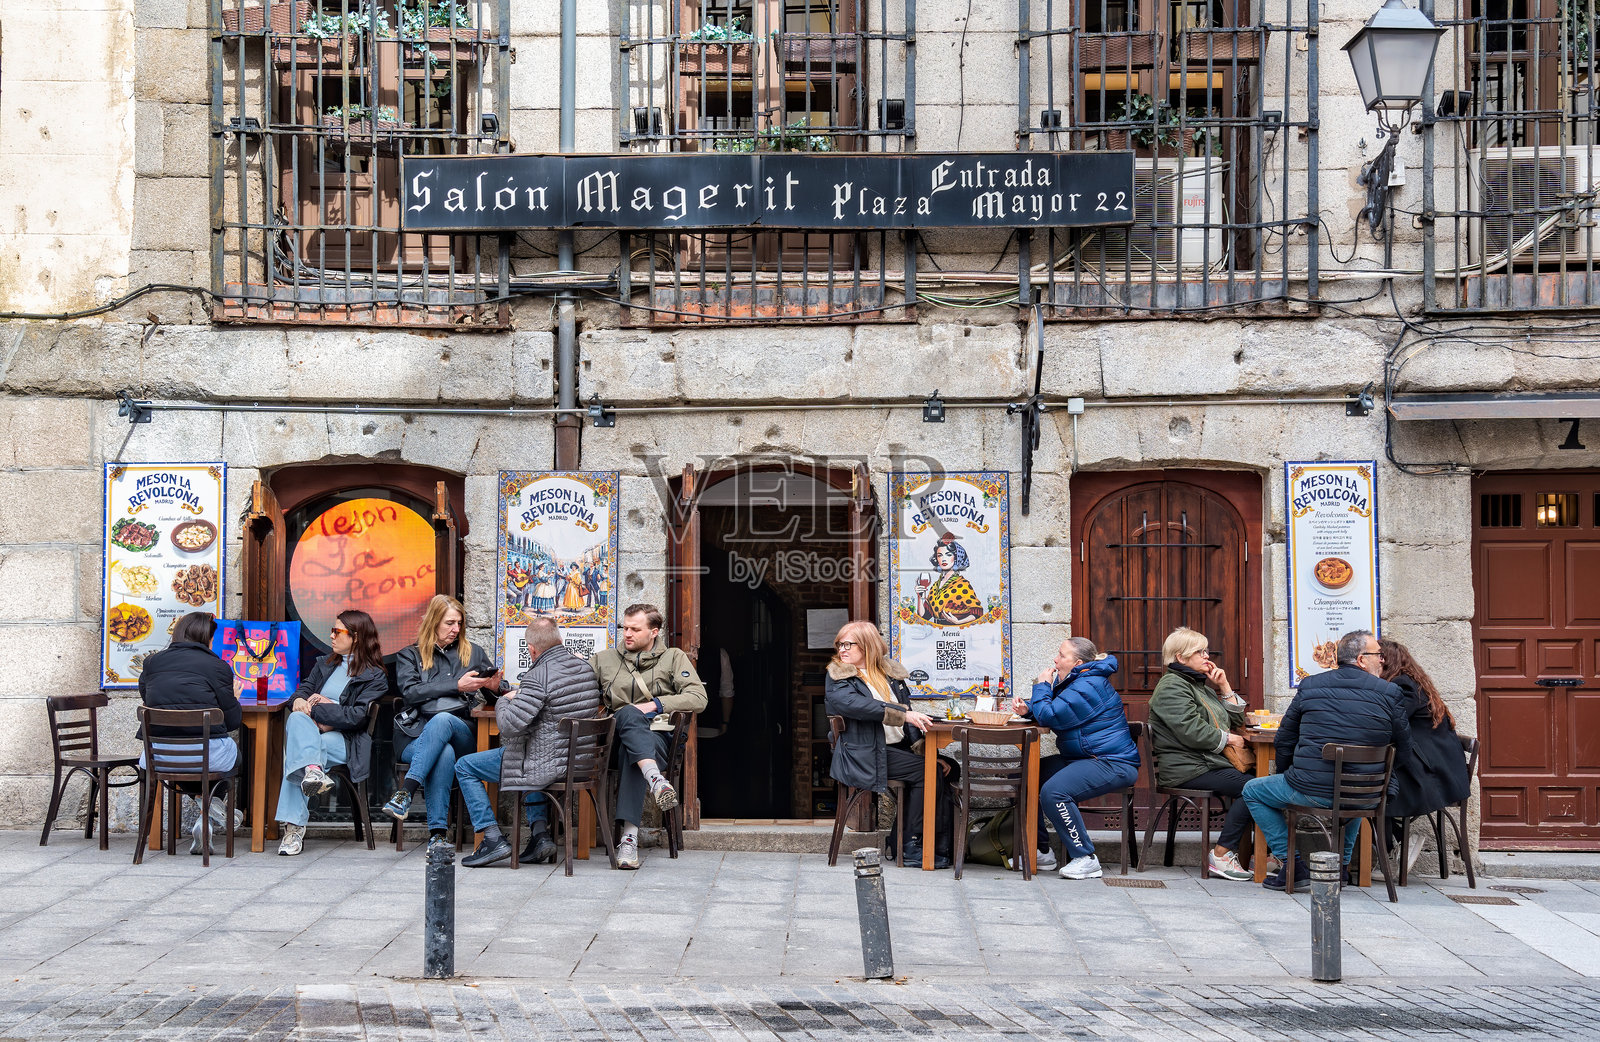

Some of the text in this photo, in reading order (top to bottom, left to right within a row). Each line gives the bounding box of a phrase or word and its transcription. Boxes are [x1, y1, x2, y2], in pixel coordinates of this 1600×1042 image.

[931, 158, 1052, 195] Entrada
[408, 169, 799, 222] Salón Magerit
[831, 181, 1130, 222] Plaza Mayor 22
[1183, 194, 1206, 208] FUJITS
[136, 473, 191, 490] MESON LA
[1300, 474, 1358, 492] MESON LA
[128, 487, 200, 507] REVOLCONA
[530, 488, 586, 506] MESON LA
[920, 490, 976, 508] MESON LA
[1293, 488, 1367, 510] REVOLCONA
[521, 502, 594, 524] REVOLCONA
[912, 504, 985, 526] REVOLCONA
[1056, 802, 1083, 848] JACK WILLS
